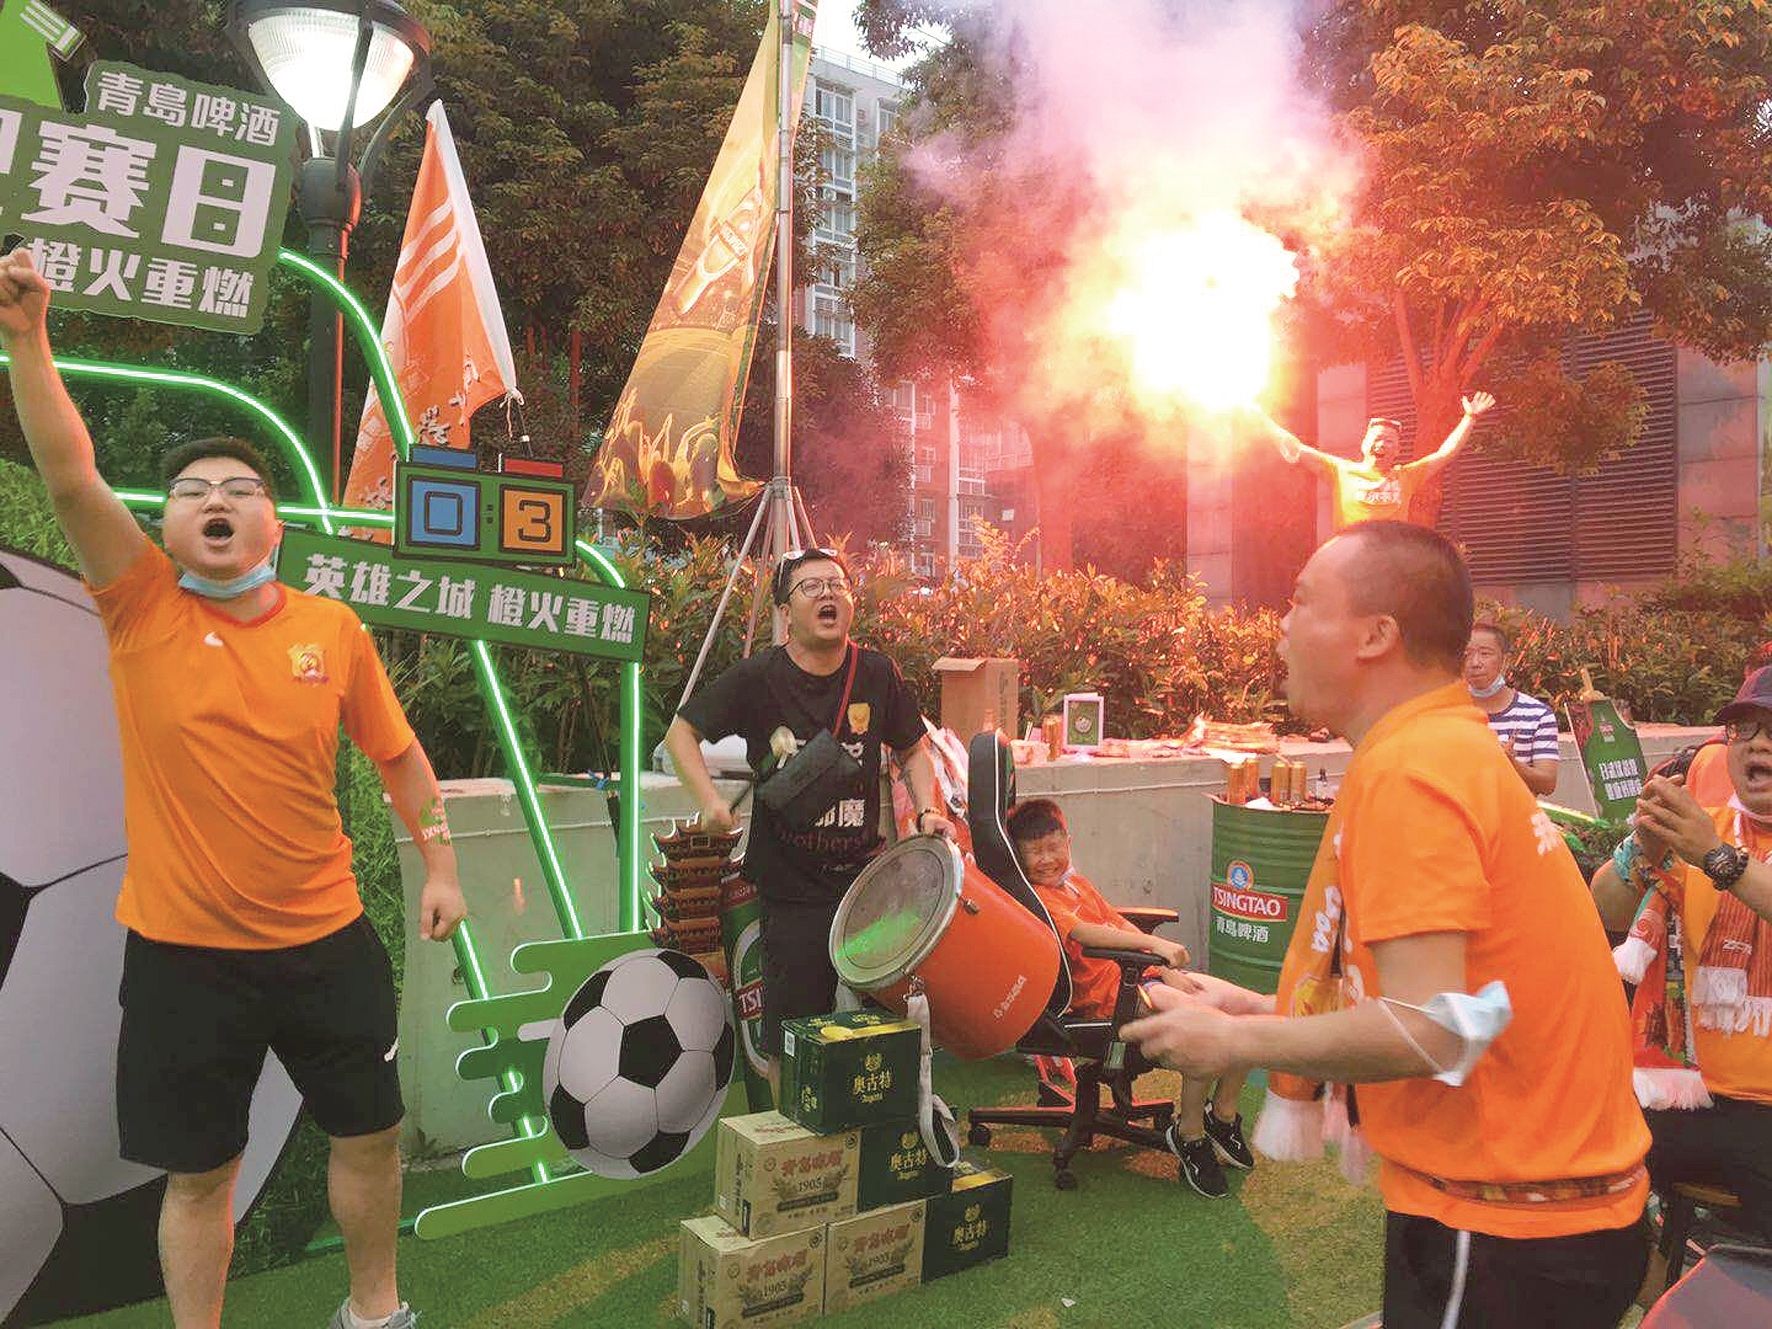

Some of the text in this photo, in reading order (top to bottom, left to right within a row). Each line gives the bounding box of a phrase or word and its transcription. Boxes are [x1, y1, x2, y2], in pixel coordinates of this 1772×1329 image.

[28, 237, 255, 319] 橙火重燃
[303, 552, 635, 644] 英雄之城 橙火重燃
[1212, 886, 1281, 917] TSINGTAO
[852, 1069, 892, 1095] 奥古特
